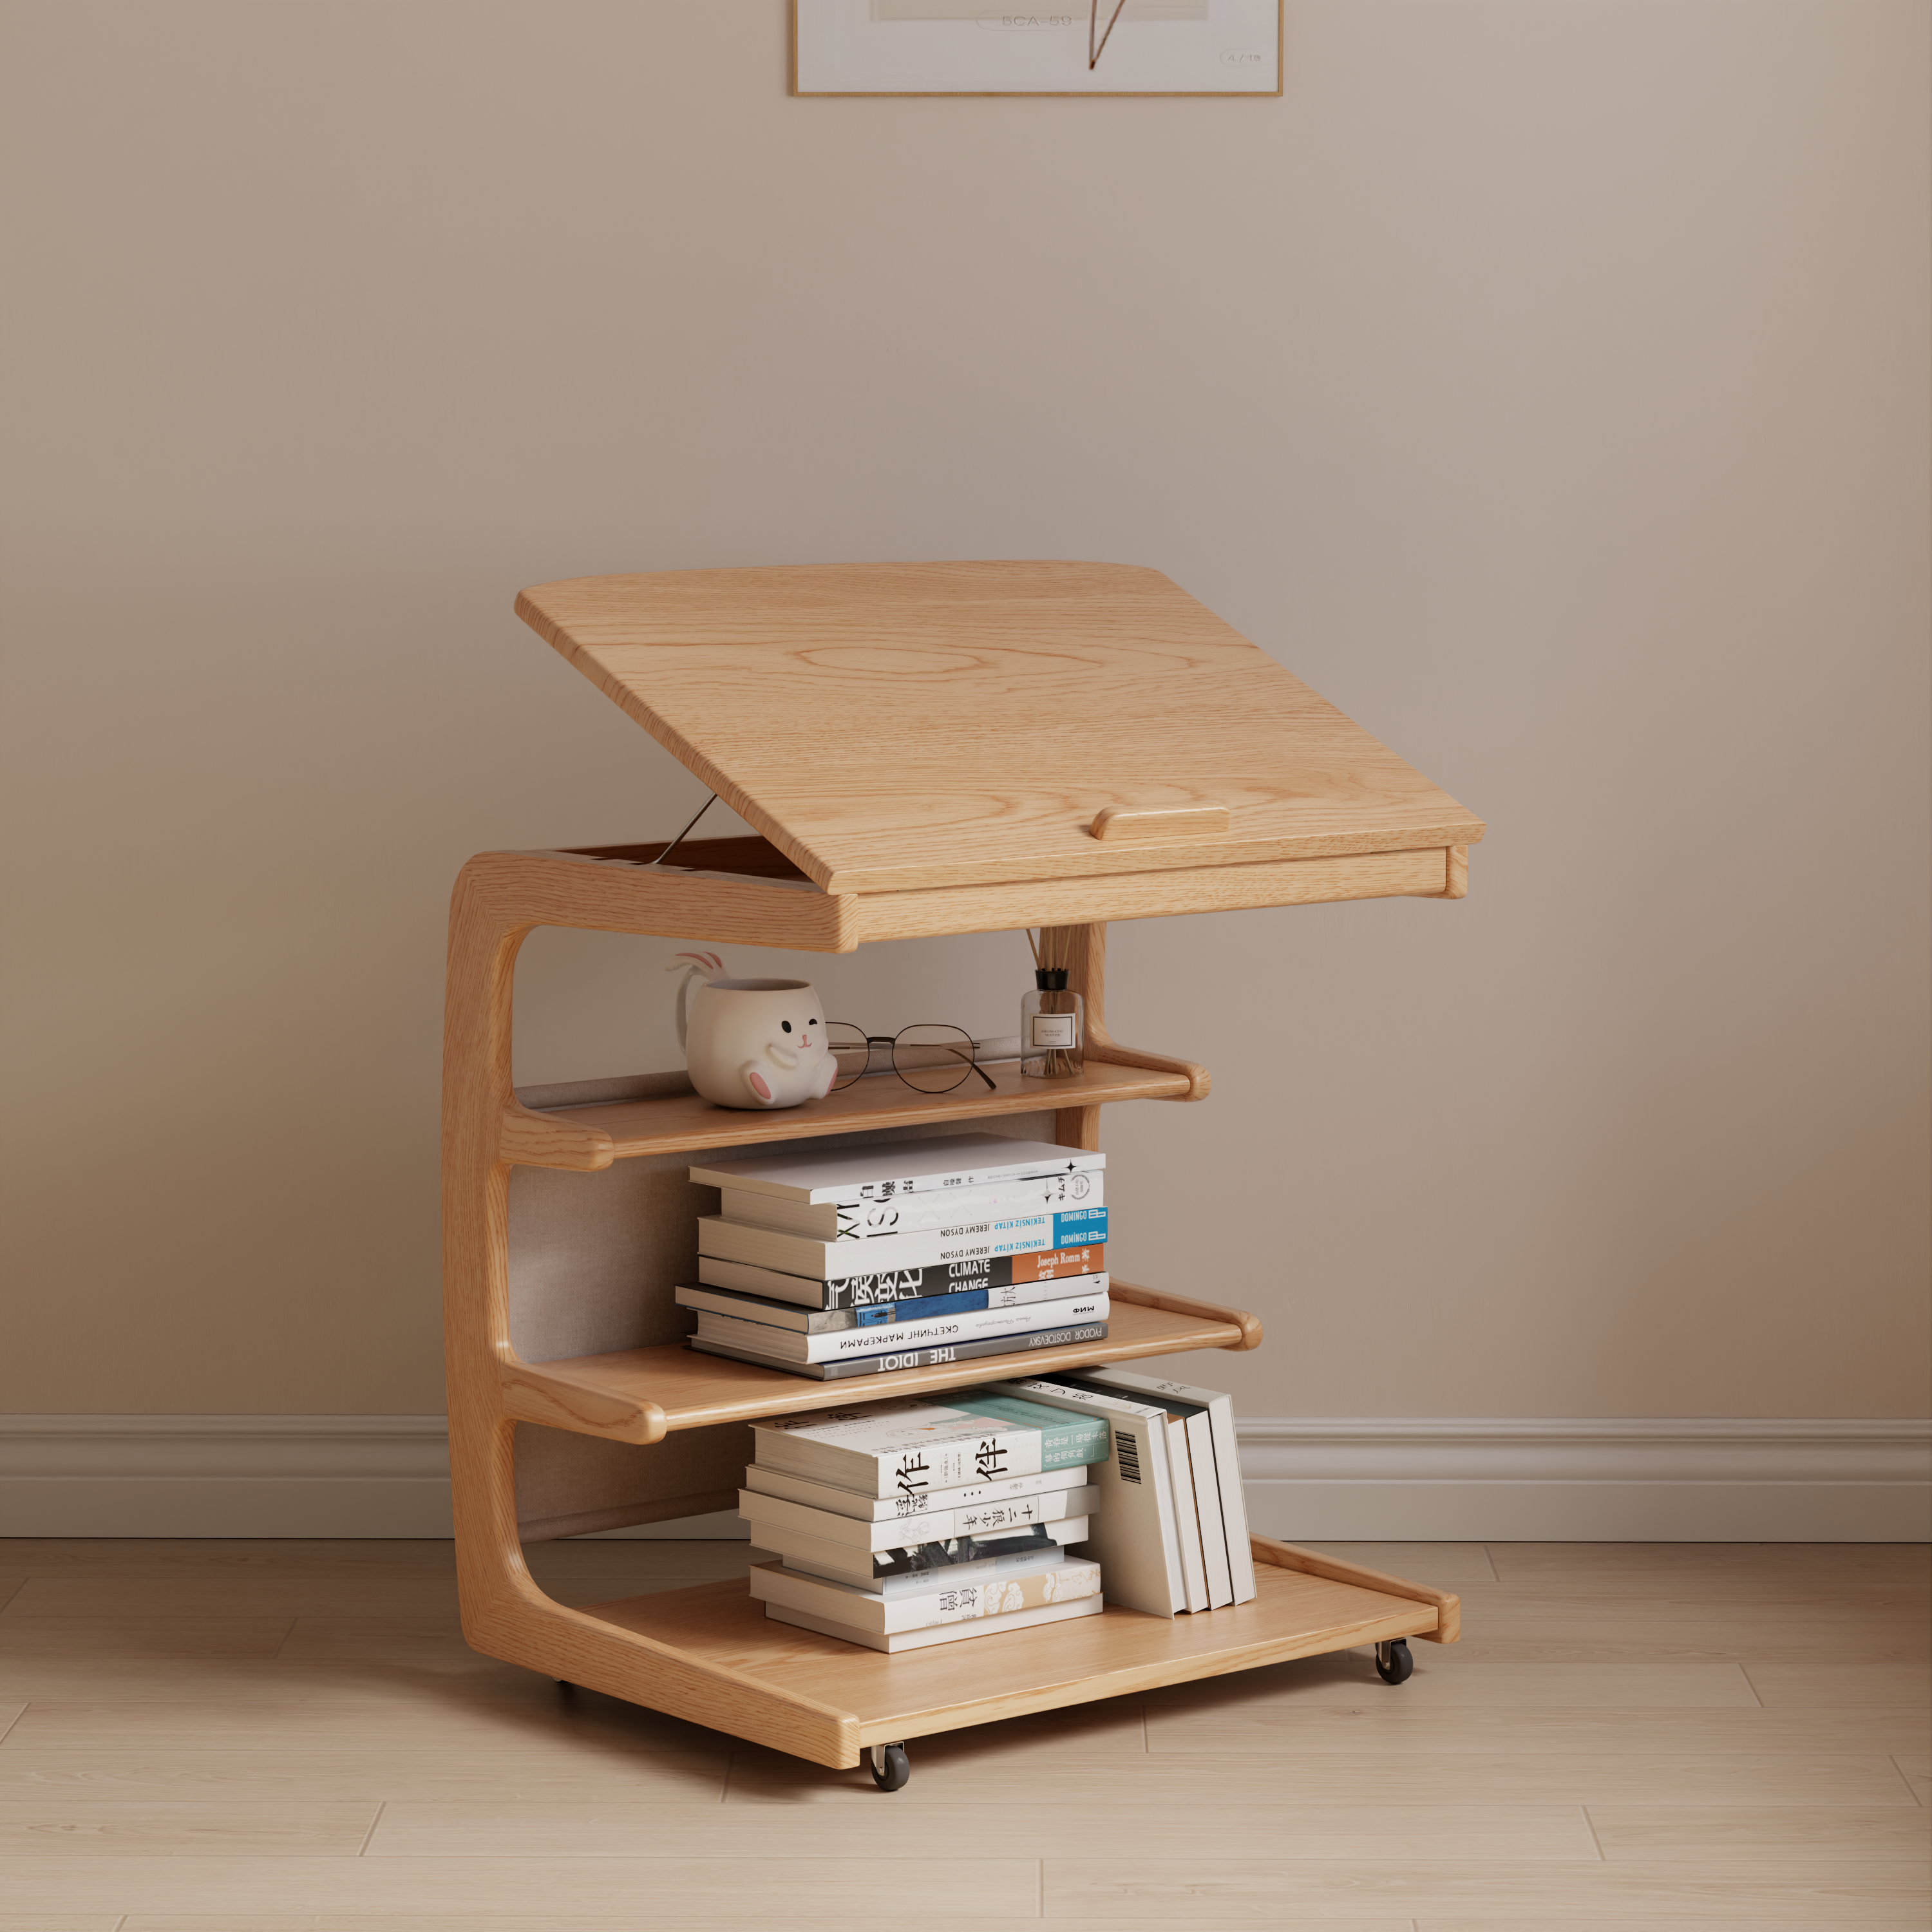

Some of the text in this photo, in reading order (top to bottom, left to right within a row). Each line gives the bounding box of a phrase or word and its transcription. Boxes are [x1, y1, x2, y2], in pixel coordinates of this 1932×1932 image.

[940, 1227, 963, 1237] DYSON
[965, 1224, 990, 1234] JEREMY
[940, 1250, 963, 1260] DYSON
[965, 1245, 990, 1256] JEREMY
[949, 1259, 990, 1278] CLIMATE
[1037, 1254, 1059, 1268] Joseph
[1060, 1253, 1081, 1264] Romm
[949, 1278, 989, 1293] CHANGE
[840, 1325, 959, 1349] СКЕТЧИНГ МАРКЕРАМИ
[1028, 1327, 1102, 1347] FYODOR DOSTOEVSKY
[878, 1347, 956, 1372] THE IDIOT
[896, 1452, 931, 1495] 作
[975, 1437, 1008, 1481] 伴
[962, 1504, 1034, 1531] 十二狼少年
[939, 1587, 978, 1611] 貧僧
